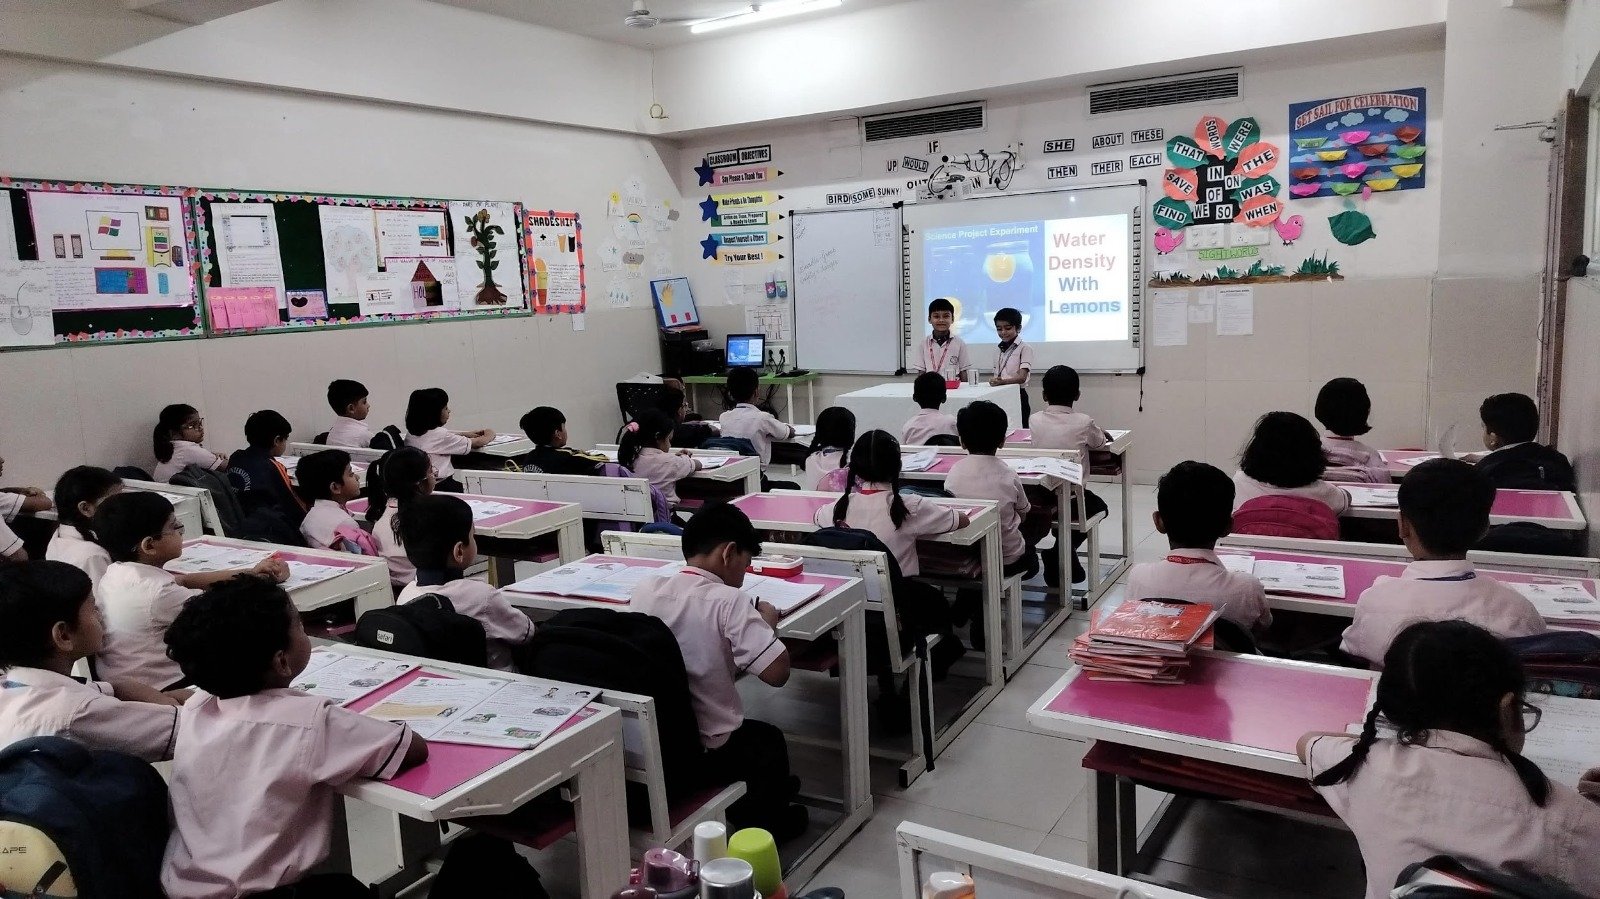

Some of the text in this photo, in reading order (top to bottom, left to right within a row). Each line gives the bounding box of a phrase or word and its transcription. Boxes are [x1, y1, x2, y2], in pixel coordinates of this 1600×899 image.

[1297, 93, 1417, 128] SET SAIL FOR CELEBRATION
[1094, 129, 1161, 147] ABOUT THESE
[1206, 120, 1221, 149] WORDS
[1230, 121, 1251, 152] WERE
[928, 141, 939, 153] IF
[1046, 140, 1072, 151] SHE
[1174, 143, 1203, 161] THAT
[709, 149, 768, 165] CLASSROOM OBJECTIVES
[904, 158, 927, 171] WOULD
[1093, 155, 1160, 174] THEIR EACH
[1243, 151, 1274, 171] THE
[887, 160, 897, 171] UP
[1049, 165, 1076, 178] THEN
[1209, 167, 1222, 180] IN
[729, 174, 741, 182] Please
[1166, 173, 1193, 194] SAVE
[1226, 177, 1240, 188] ON
[828, 187, 900, 204] BIRD SOME SUNNY
[1208, 189, 1221, 201] OF
[1241, 181, 1272, 200] WAS
[1157, 205, 1186, 222] FIND
[1194, 204, 1209, 217] WE
[1217, 206, 1231, 218] SO
[1246, 203, 1277, 220] WHEN
[529, 216, 578, 227] SHADESHIFT
[925, 225, 1039, 241] Science Project Experiment
[1053, 232, 1106, 248] Water
[724, 254, 733, 262] Try
[733, 253, 747, 261] Your
[747, 252, 760, 260] Best
[1049, 254, 1116, 271] Density
[1058, 275, 1099, 292] With
[1050, 299, 1121, 315] Lemons
[0, 846, 27, 854] APE
